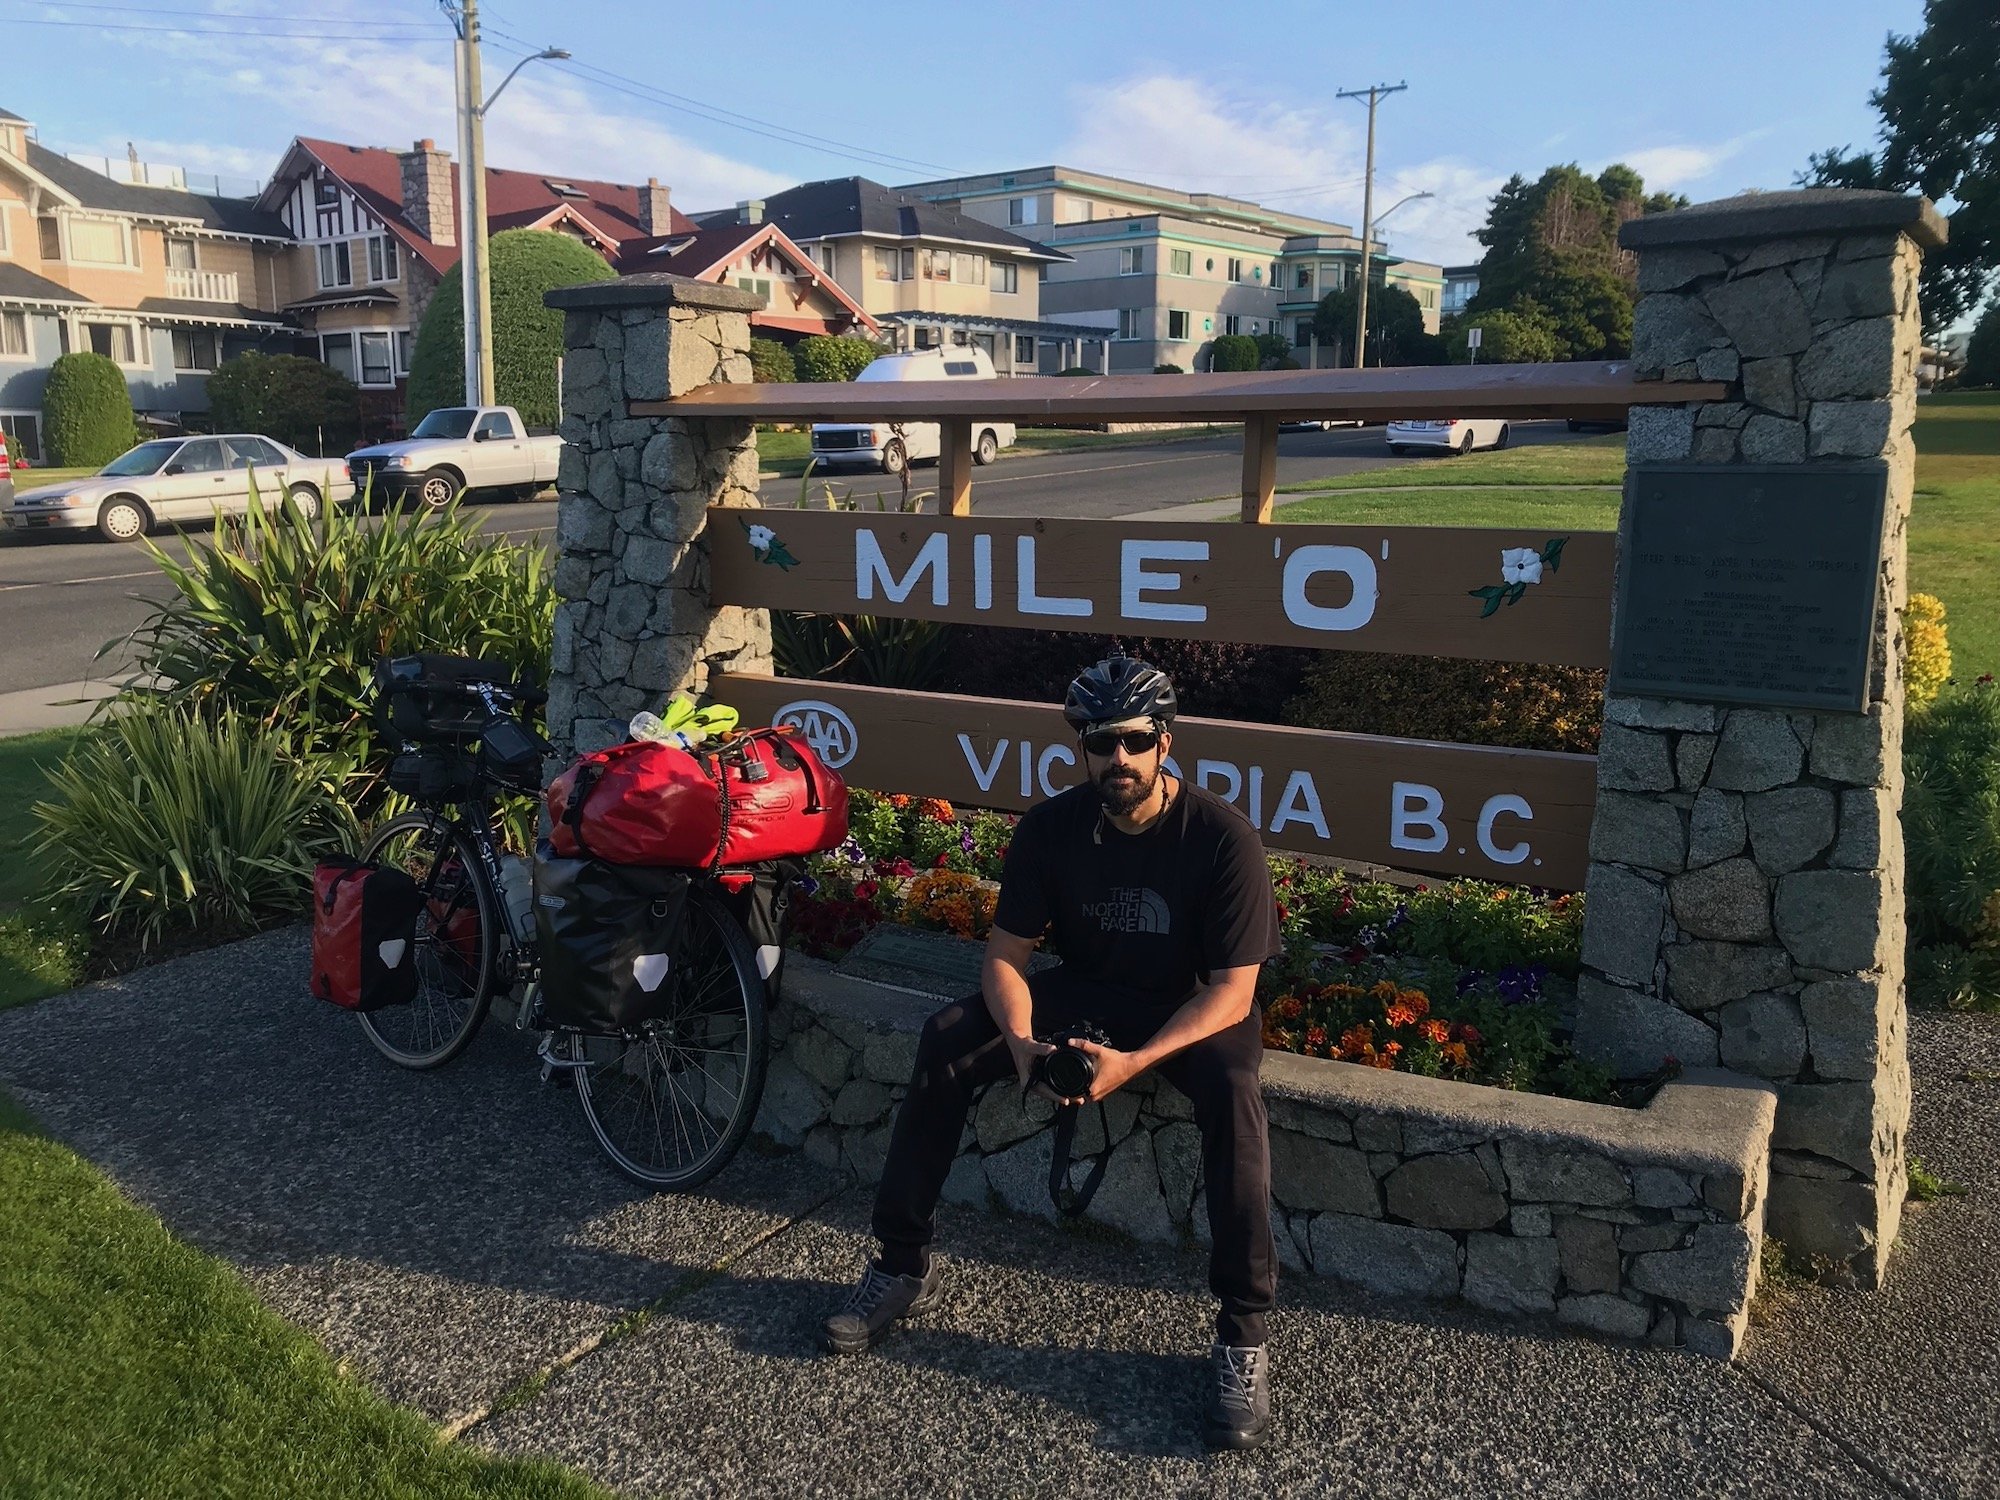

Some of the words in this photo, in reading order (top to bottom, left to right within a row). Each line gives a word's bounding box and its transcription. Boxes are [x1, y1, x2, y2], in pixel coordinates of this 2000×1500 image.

[855, 528, 1210, 623] MILE
[956, 732, 1331, 840] VICRIA
[1390, 780, 1543, 866] B.C.
[1110, 886, 1141, 903] THE
[1082, 902, 1139, 918] NORTH
[1100, 916, 1137, 933] FACE
